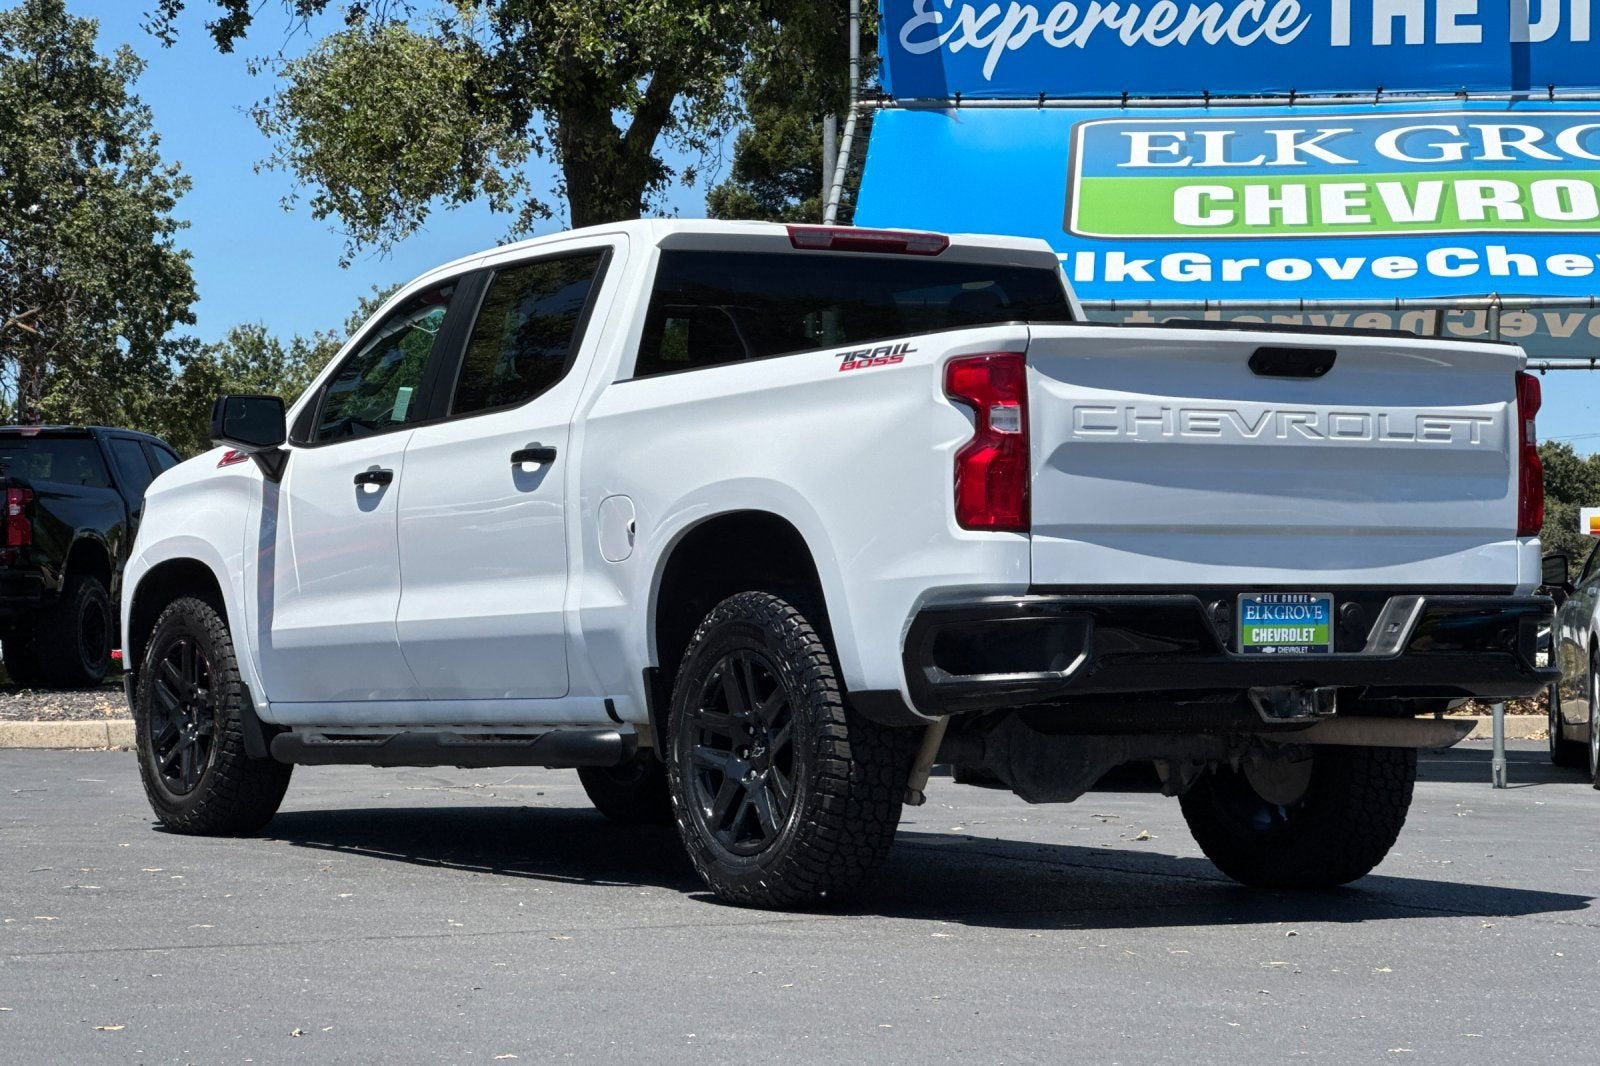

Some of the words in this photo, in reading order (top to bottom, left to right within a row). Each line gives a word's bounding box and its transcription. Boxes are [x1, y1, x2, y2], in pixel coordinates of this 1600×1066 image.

[899, 0, 1312, 81] Experience
[1116, 127, 1359, 167] ELK
[1057, 245, 1600, 283] lkGroveChe
[835, 342, 918, 363] TRAIL
[838, 354, 906, 372] BOSS
[1072, 405, 1494, 445] CHEVROLET
[1263, 594, 1278, 603] ELK
[1281, 594, 1308, 603] GROVE
[1245, 605, 1275, 620] ELK
[1274, 605, 1323, 620] GROVE
[1251, 627, 1316, 643] CHEVROLET
[1277, 646, 1309, 654] CHEVROLET
